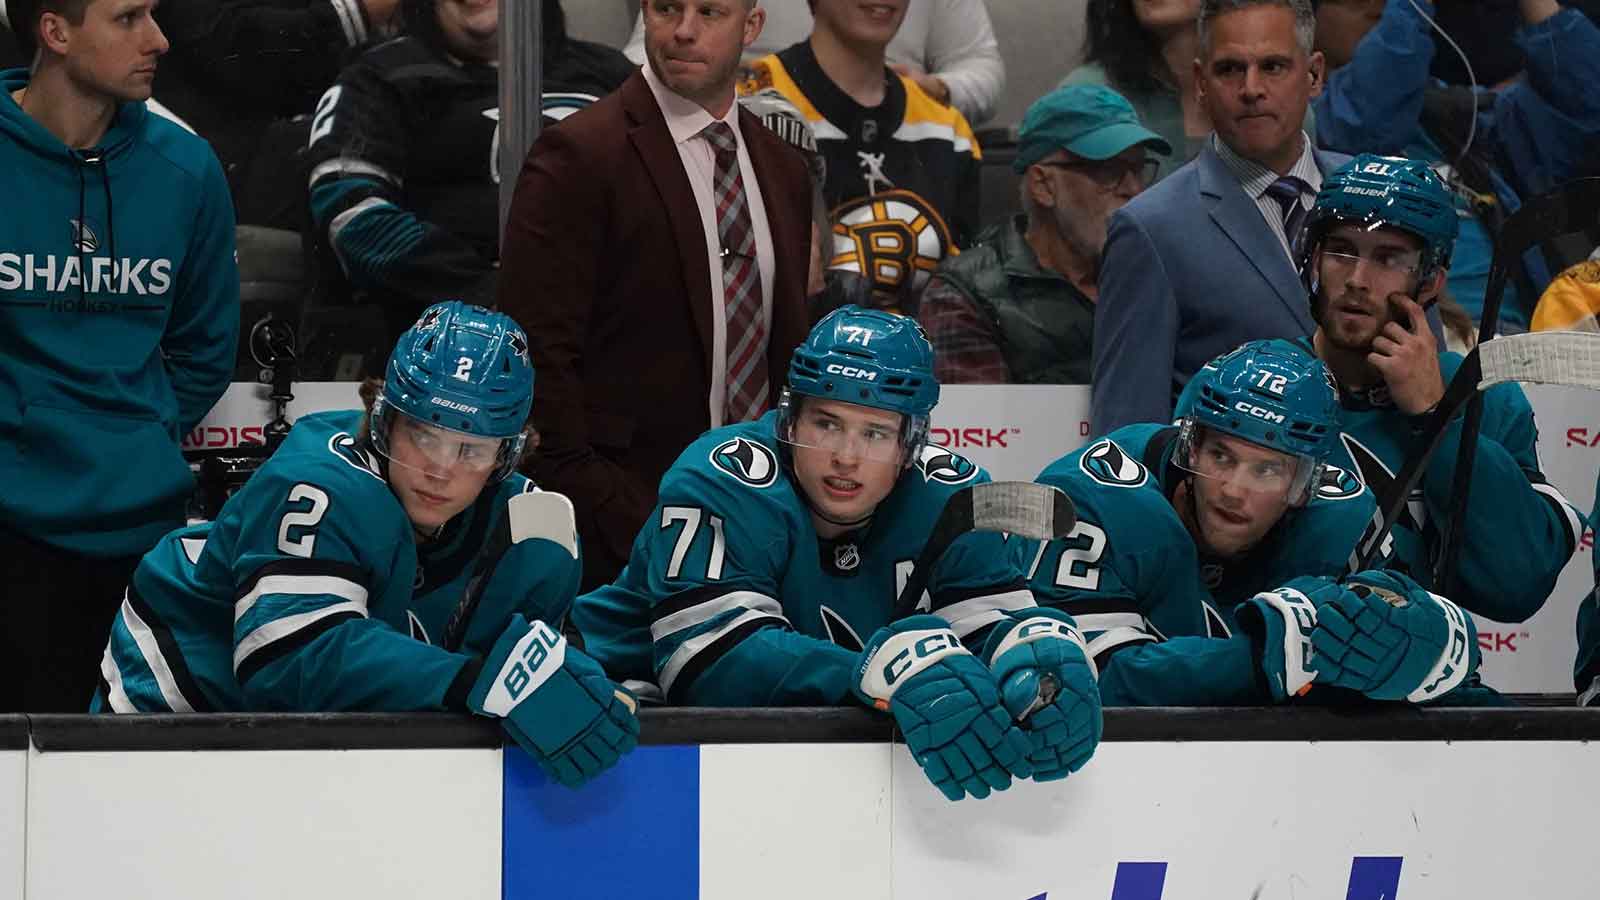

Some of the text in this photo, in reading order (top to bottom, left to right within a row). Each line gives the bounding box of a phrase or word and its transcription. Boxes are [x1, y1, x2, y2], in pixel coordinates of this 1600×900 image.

[309, 86, 342, 150] 2
[1343, 186, 1388, 197] BAUER
[849, 220, 917, 291] B
[0, 253, 172, 295] SHARKS
[842, 325, 873, 346] 71
[454, 356, 473, 382] 2
[826, 364, 877, 381] CCM
[1256, 369, 1288, 395] 72
[431, 397, 480, 414] BAUER
[1235, 401, 1286, 424] CCM
[277, 483, 329, 559] 2
[661, 506, 725, 580] 71
